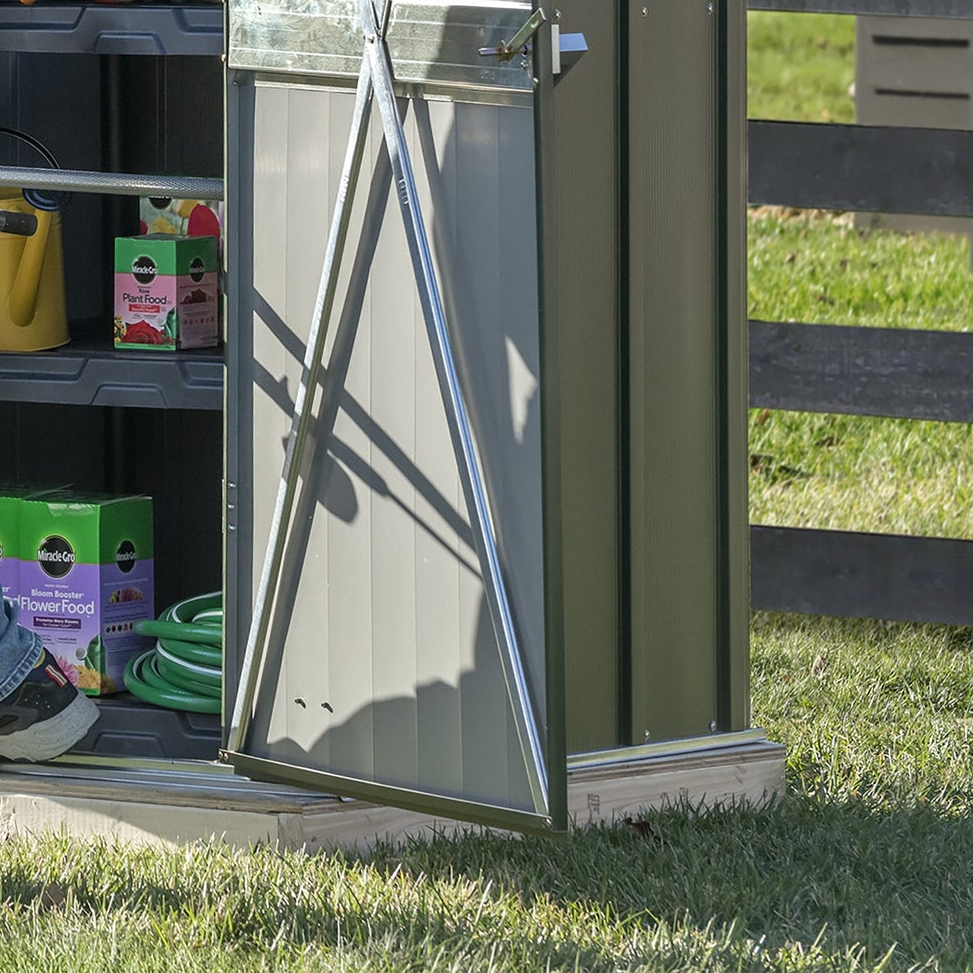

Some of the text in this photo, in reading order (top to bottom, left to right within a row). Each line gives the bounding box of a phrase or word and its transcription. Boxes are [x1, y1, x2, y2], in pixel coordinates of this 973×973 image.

[123, 293, 167, 304] Plant Food
[31, 588, 83, 600] Bloom Booster
[20, 596, 61, 613] Flower
[61, 599, 95, 615] Food
